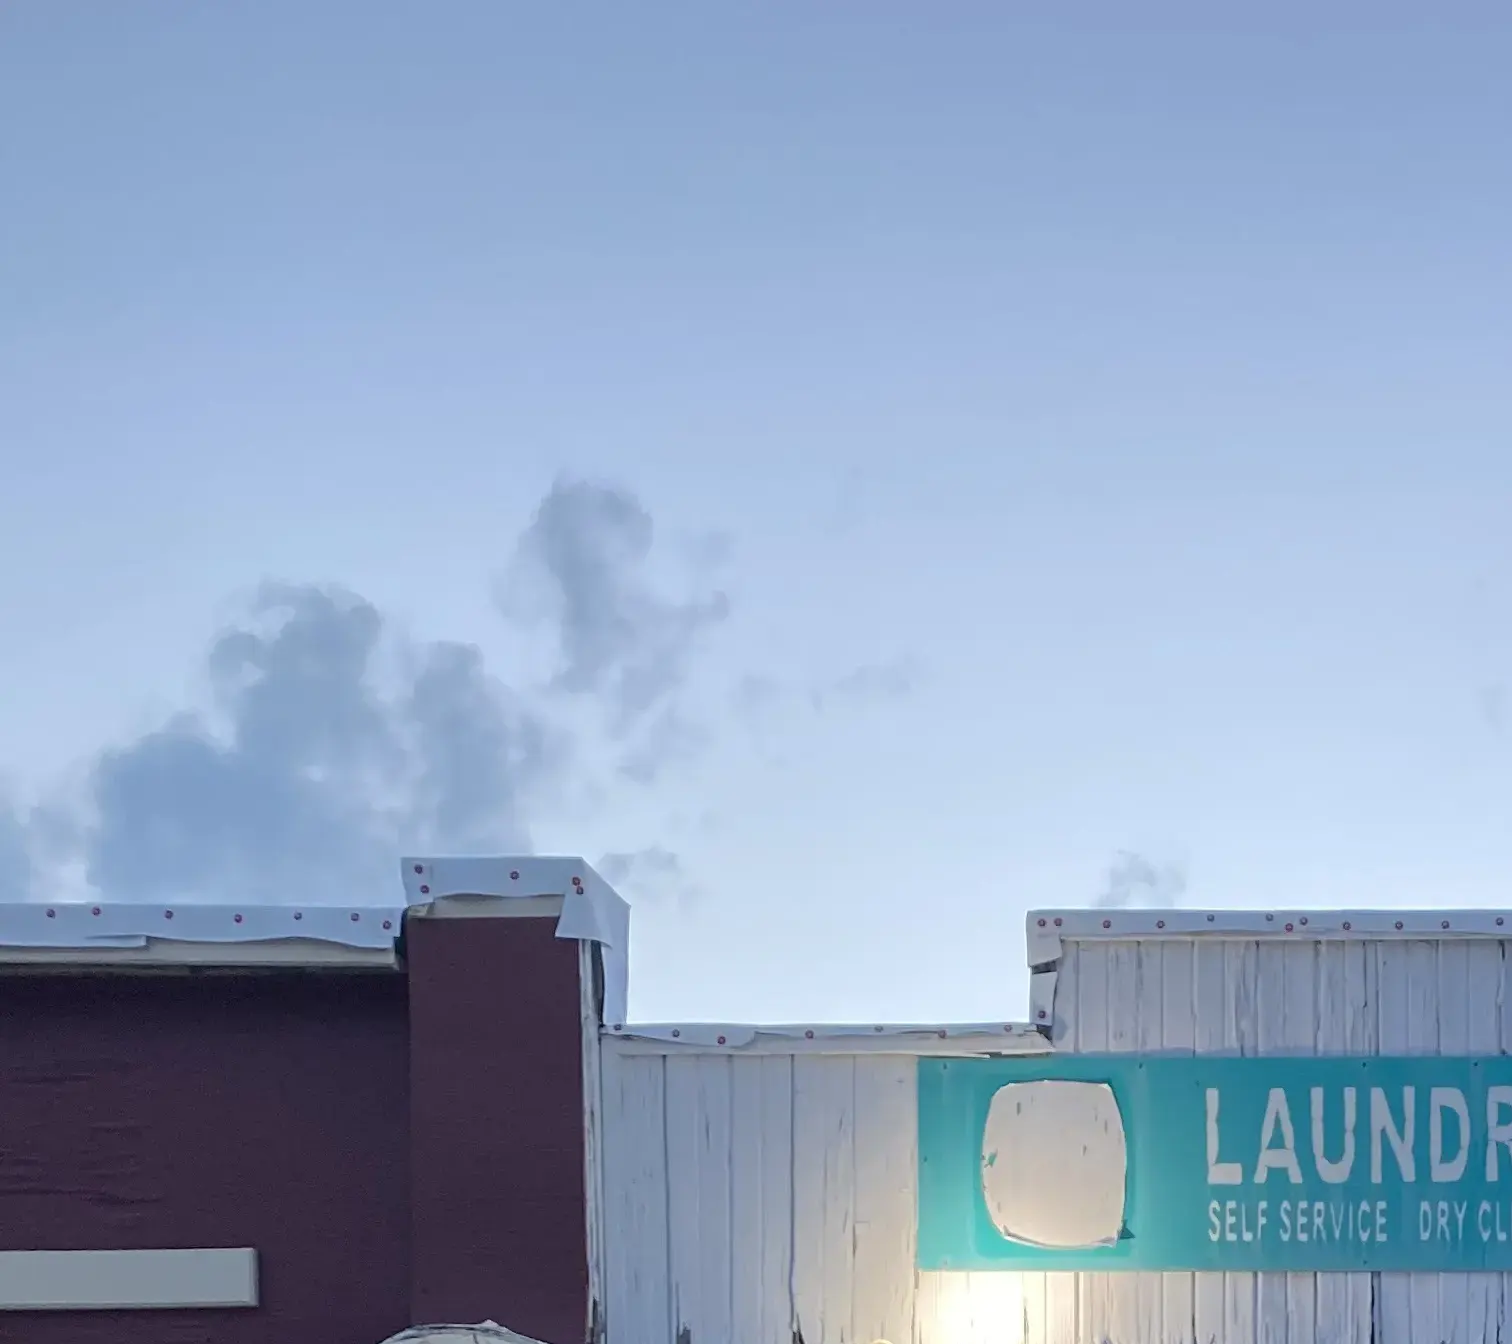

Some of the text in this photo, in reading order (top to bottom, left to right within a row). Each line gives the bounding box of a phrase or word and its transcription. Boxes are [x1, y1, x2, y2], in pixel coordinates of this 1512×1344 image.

[1207, 1200, 1268, 1242] SELF
[1279, 1200, 1388, 1242] SERVICE
[1419, 1200, 1468, 1242] DRY
